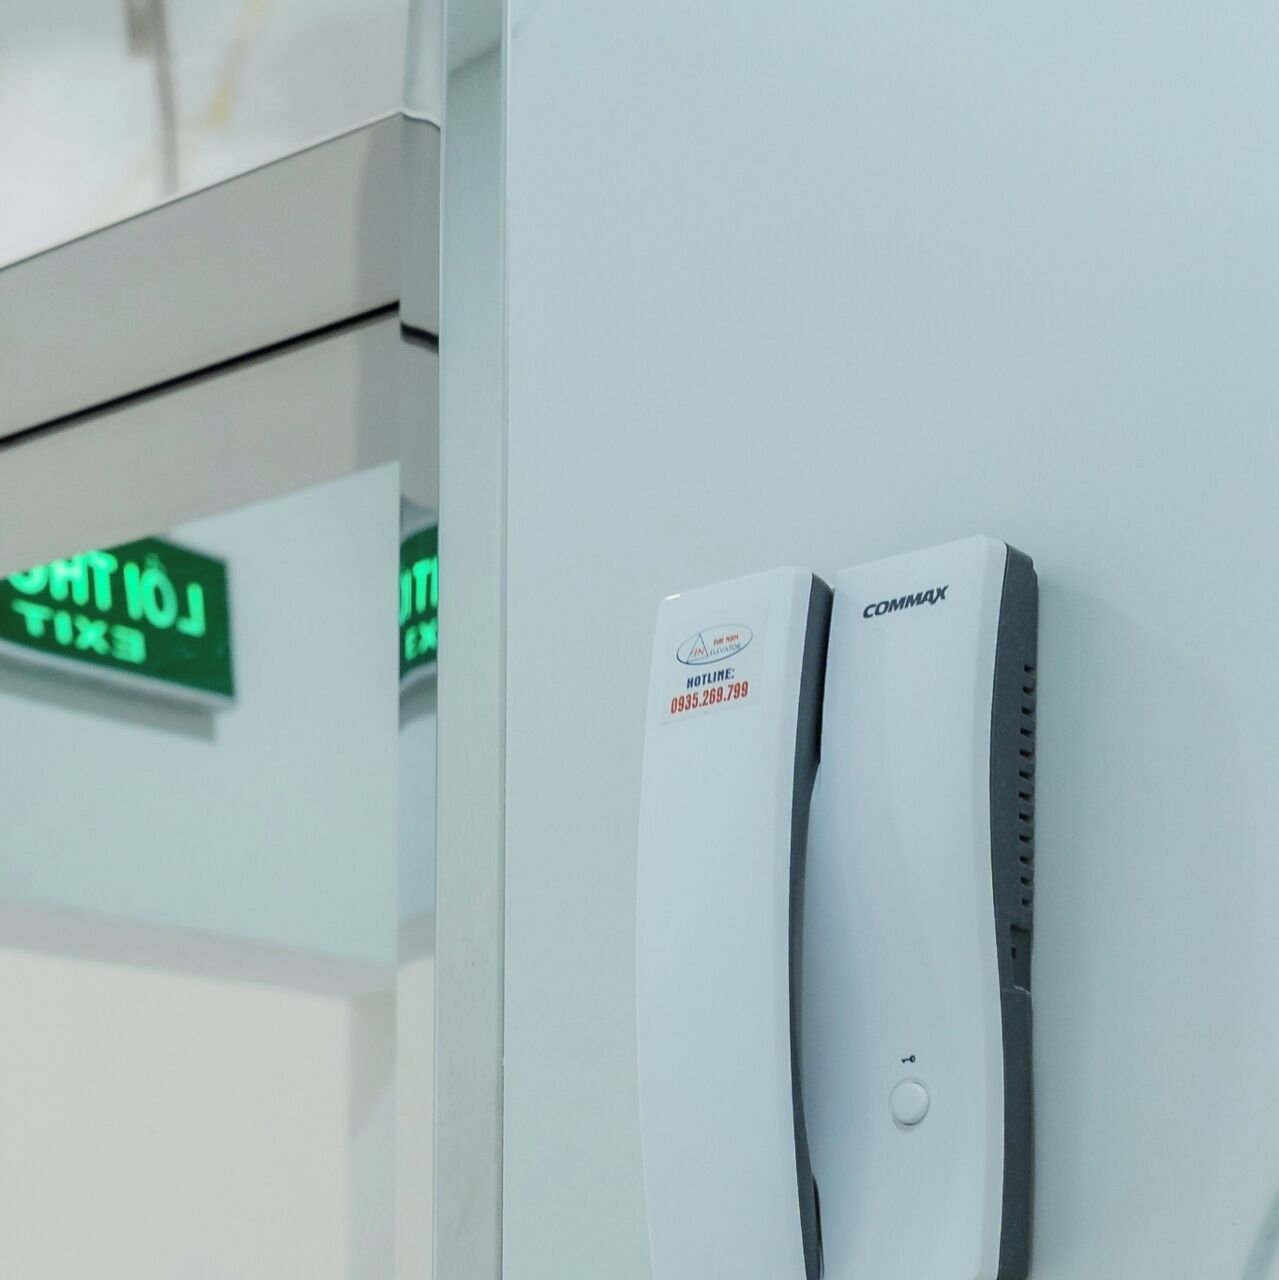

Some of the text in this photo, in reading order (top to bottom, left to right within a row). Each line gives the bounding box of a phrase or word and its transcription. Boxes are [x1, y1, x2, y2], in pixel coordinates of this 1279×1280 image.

[863, 585, 949, 619] COMMAX
[686, 668, 734, 689] HOTLINE:
[671, 681, 749, 714] 0935.269.799
